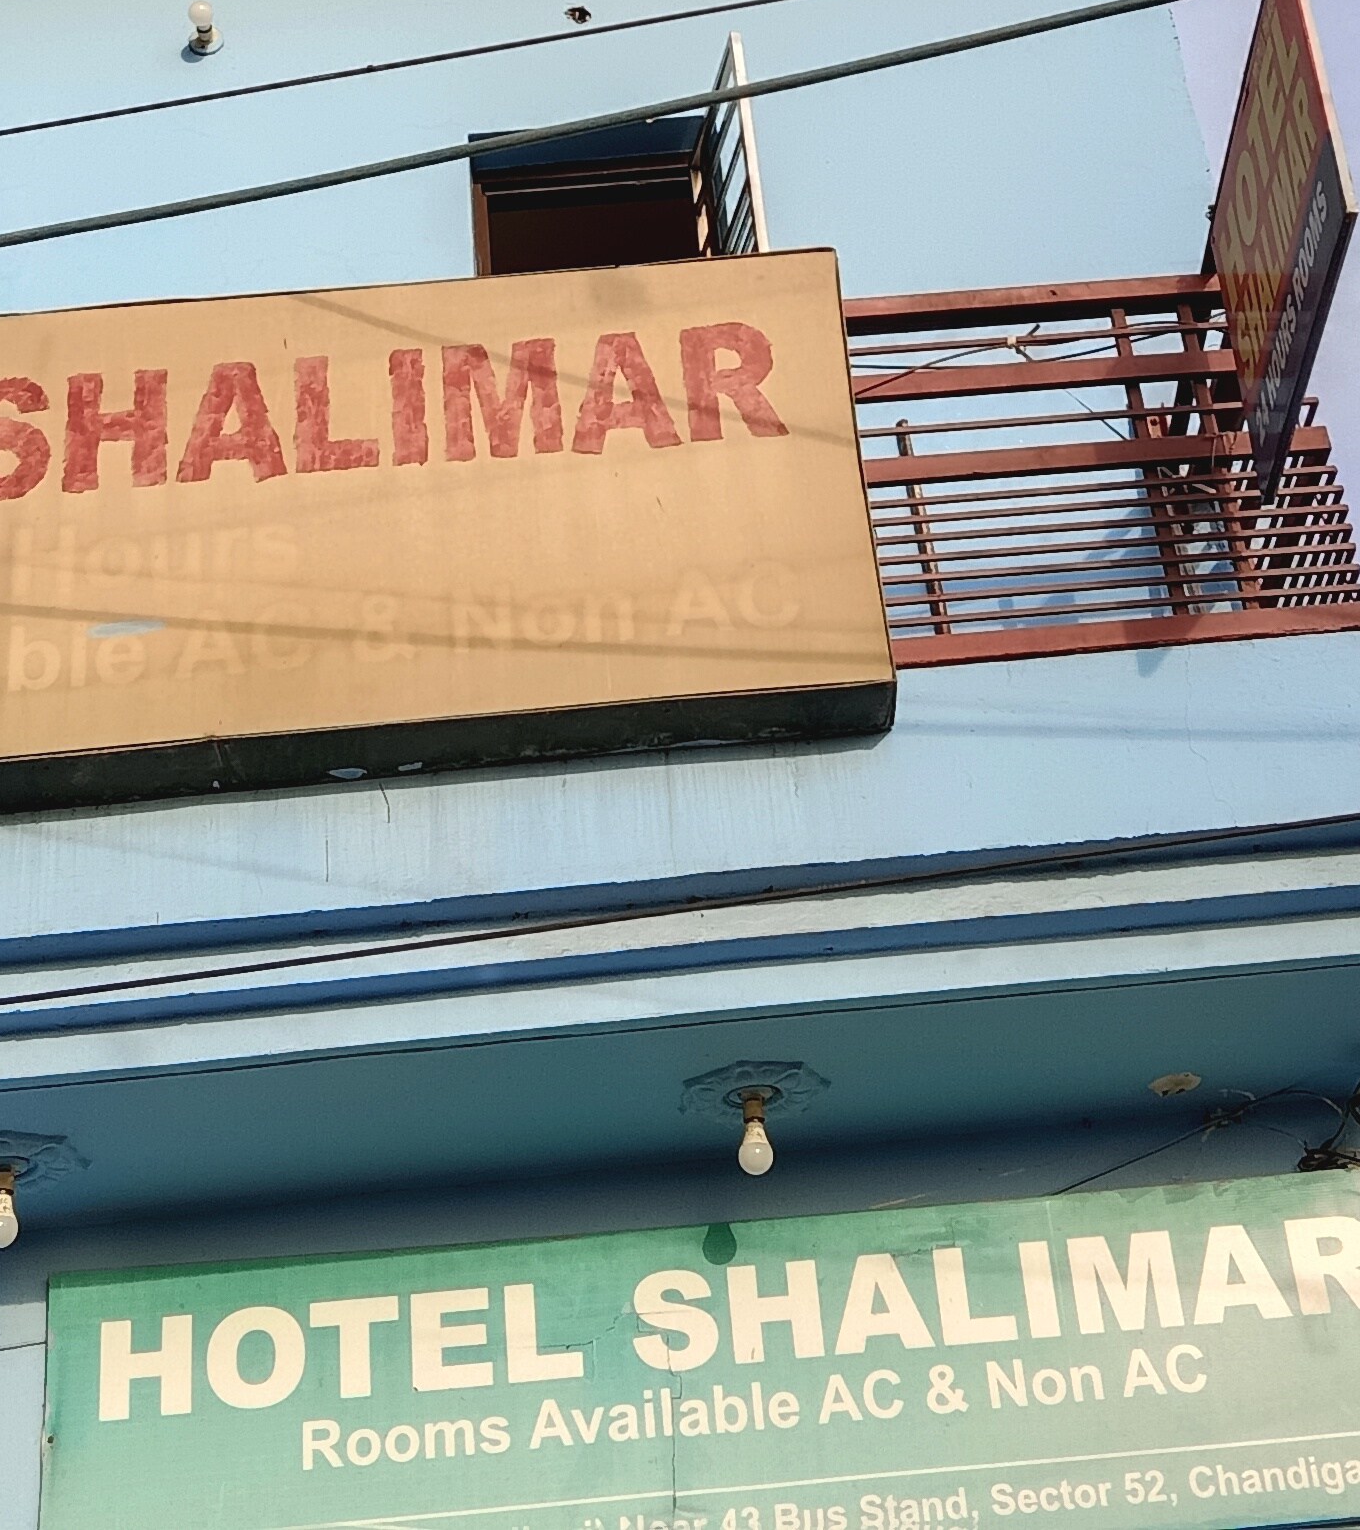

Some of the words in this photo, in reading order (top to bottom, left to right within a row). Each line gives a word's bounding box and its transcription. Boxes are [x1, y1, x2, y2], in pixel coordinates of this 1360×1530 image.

[1219, 6, 1301, 314] HOTEL
[1236, 76, 1318, 390] SHALIMAR
[1264, 292, 1298, 411] HOURS
[1291, 179, 1328, 311] ROOMS
[10, 522, 303, 604] Hours
[450, 580, 635, 655] Non
[665, 560, 801, 637] AC
[96, 1282, 585, 1423] HOTEL
[301, 1414, 511, 1471] Rooms
[529, 1385, 800, 1450] Available
[818, 1369, 905, 1426] AC
[925, 1363, 970, 1416] &
[985, 1357, 1106, 1410] Non
[1123, 1343, 1209, 1398] AC
[774, 1502, 849, 1530] Bus
[860, 1486, 980, 1528] Stand,
[990, 1473, 1112, 1517] Sector
[1124, 1471, 1179, 1506] 52,
